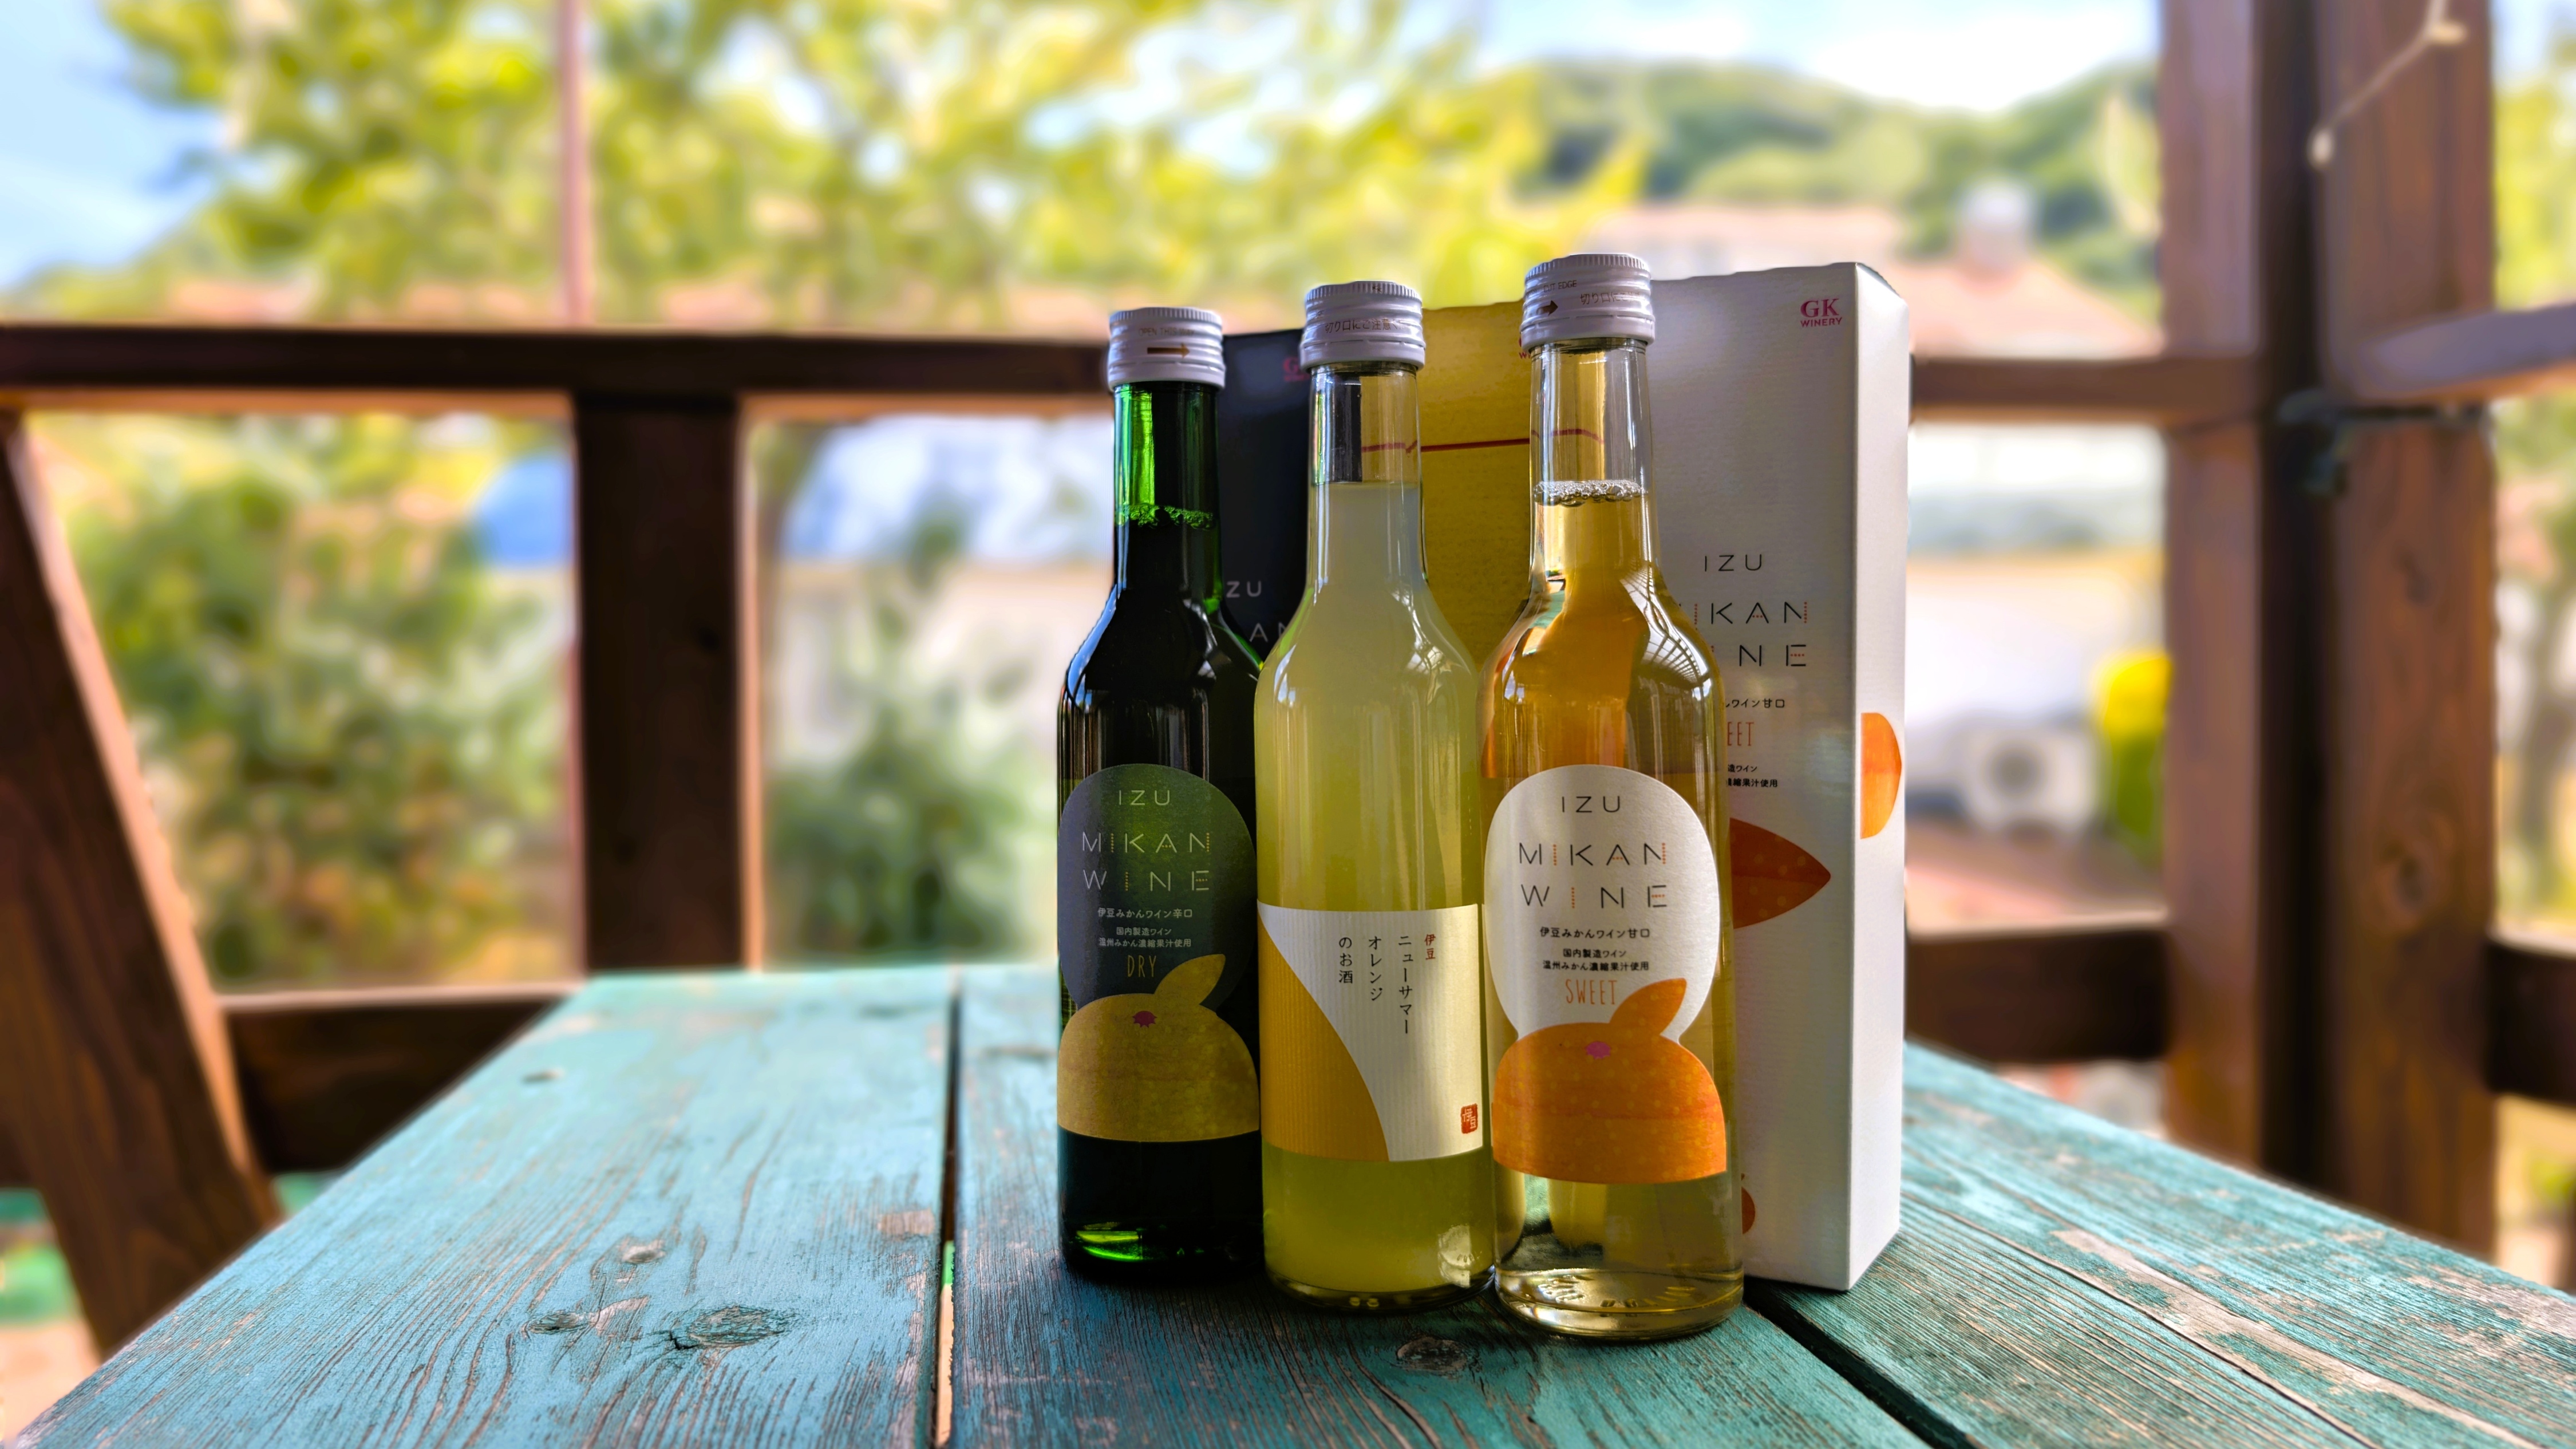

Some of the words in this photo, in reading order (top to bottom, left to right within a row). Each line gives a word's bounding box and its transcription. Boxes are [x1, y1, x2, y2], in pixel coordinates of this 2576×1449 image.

[1544, 283, 1556, 293] CUT
[1558, 280, 1577, 290] EDGE
[1800, 298, 1839, 318] GK
[1800, 317, 1843, 328] WINERY
[1139, 328, 1157, 337] OPEN
[1160, 327, 1176, 336] THIS
[1179, 328, 1195, 336] WAY
[1283, 357, 1299, 374] G
[1705, 554, 1763, 572] IZU
[1226, 580, 1262, 598] ZU
[1693, 601, 1808, 625] IKAN
[1710, 645, 1807, 667] NE
[1725, 698, 1785, 709] ワイン甘口
[1726, 721, 1755, 747] EET
[1728, 764, 1757, 772] 造ワイン
[1728, 777, 1779, 788] 縮果汁使用
[1118, 789, 1171, 806] IZU
[1562, 795, 1621, 813] IZU
[1082, 831, 1210, 854] MIKAN
[1519, 842, 1667, 866] MIKAN
[1082, 868, 1210, 892] WINE
[1520, 884, 1668, 909] WINE
[1097, 907, 1192, 919] 伊豆みかんワイン辛口
[1116, 926, 1172, 936] 国内製造ワイン
[1539, 926, 1650, 939] 伊豆みかんワイン甘口
[1425, 934, 1436, 961] 伊豆
[1563, 948, 1627, 958] 国内製造ワイン
[1127, 954, 1157, 978] DRY
[1338, 936, 1353, 985] のお酒
[1368, 935, 1383, 1002] オレンジ
[1542, 960, 1649, 972] 温州みかん濃縮果汁使用
[1398, 935, 1414, 1035] ニューサマー
[1565, 978, 1618, 1005] SWEET
